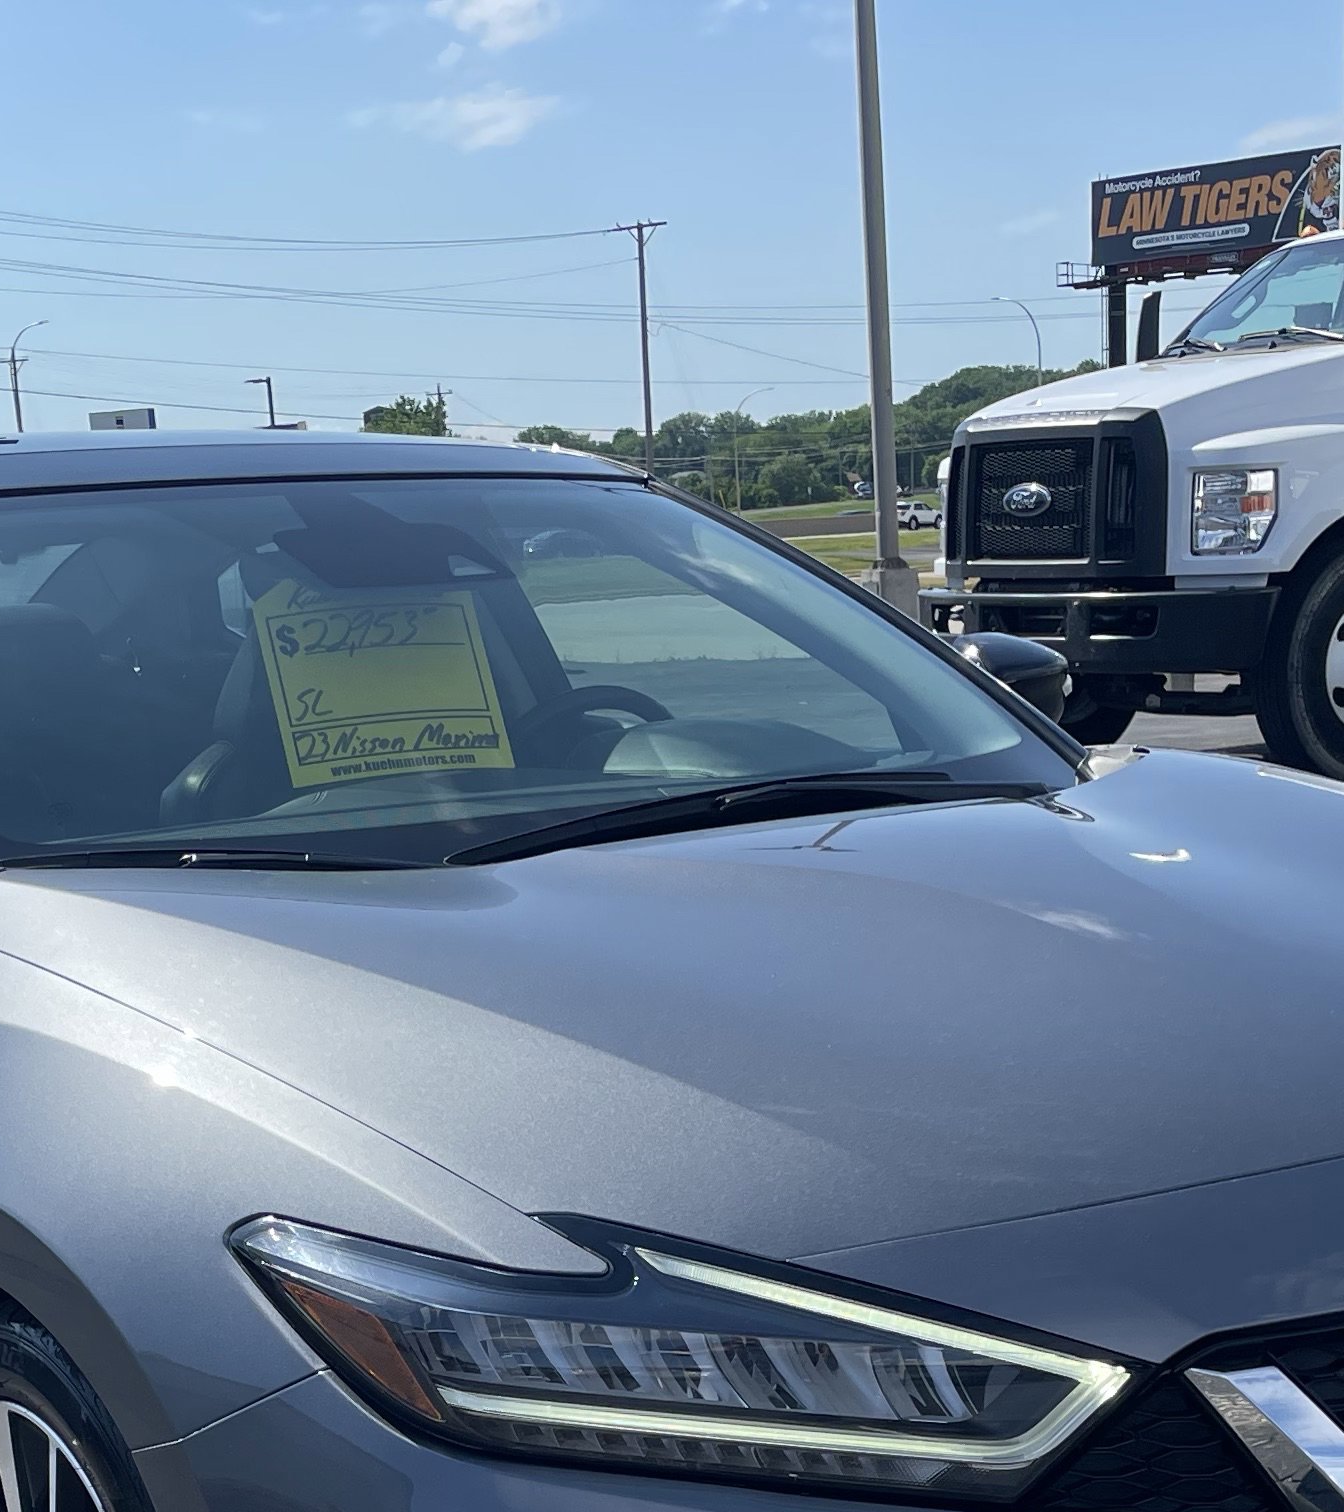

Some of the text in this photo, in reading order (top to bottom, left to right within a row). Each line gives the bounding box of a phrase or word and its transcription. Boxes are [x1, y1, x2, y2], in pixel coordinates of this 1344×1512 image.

[1105, 170, 1201, 195] Motorcycle Accident?
[1098, 170, 1293, 238] LAW TIGERS
[1176, 230, 1217, 242] MOTORCYCLE
[1217, 226, 1246, 237] LAWYERS
[295, 688, 333, 722] SL
[333, 727, 405, 757] Nissan
[413, 722, 500, 751] Maxima
[331, 753, 476, 777] www.kuehnmotors.com
